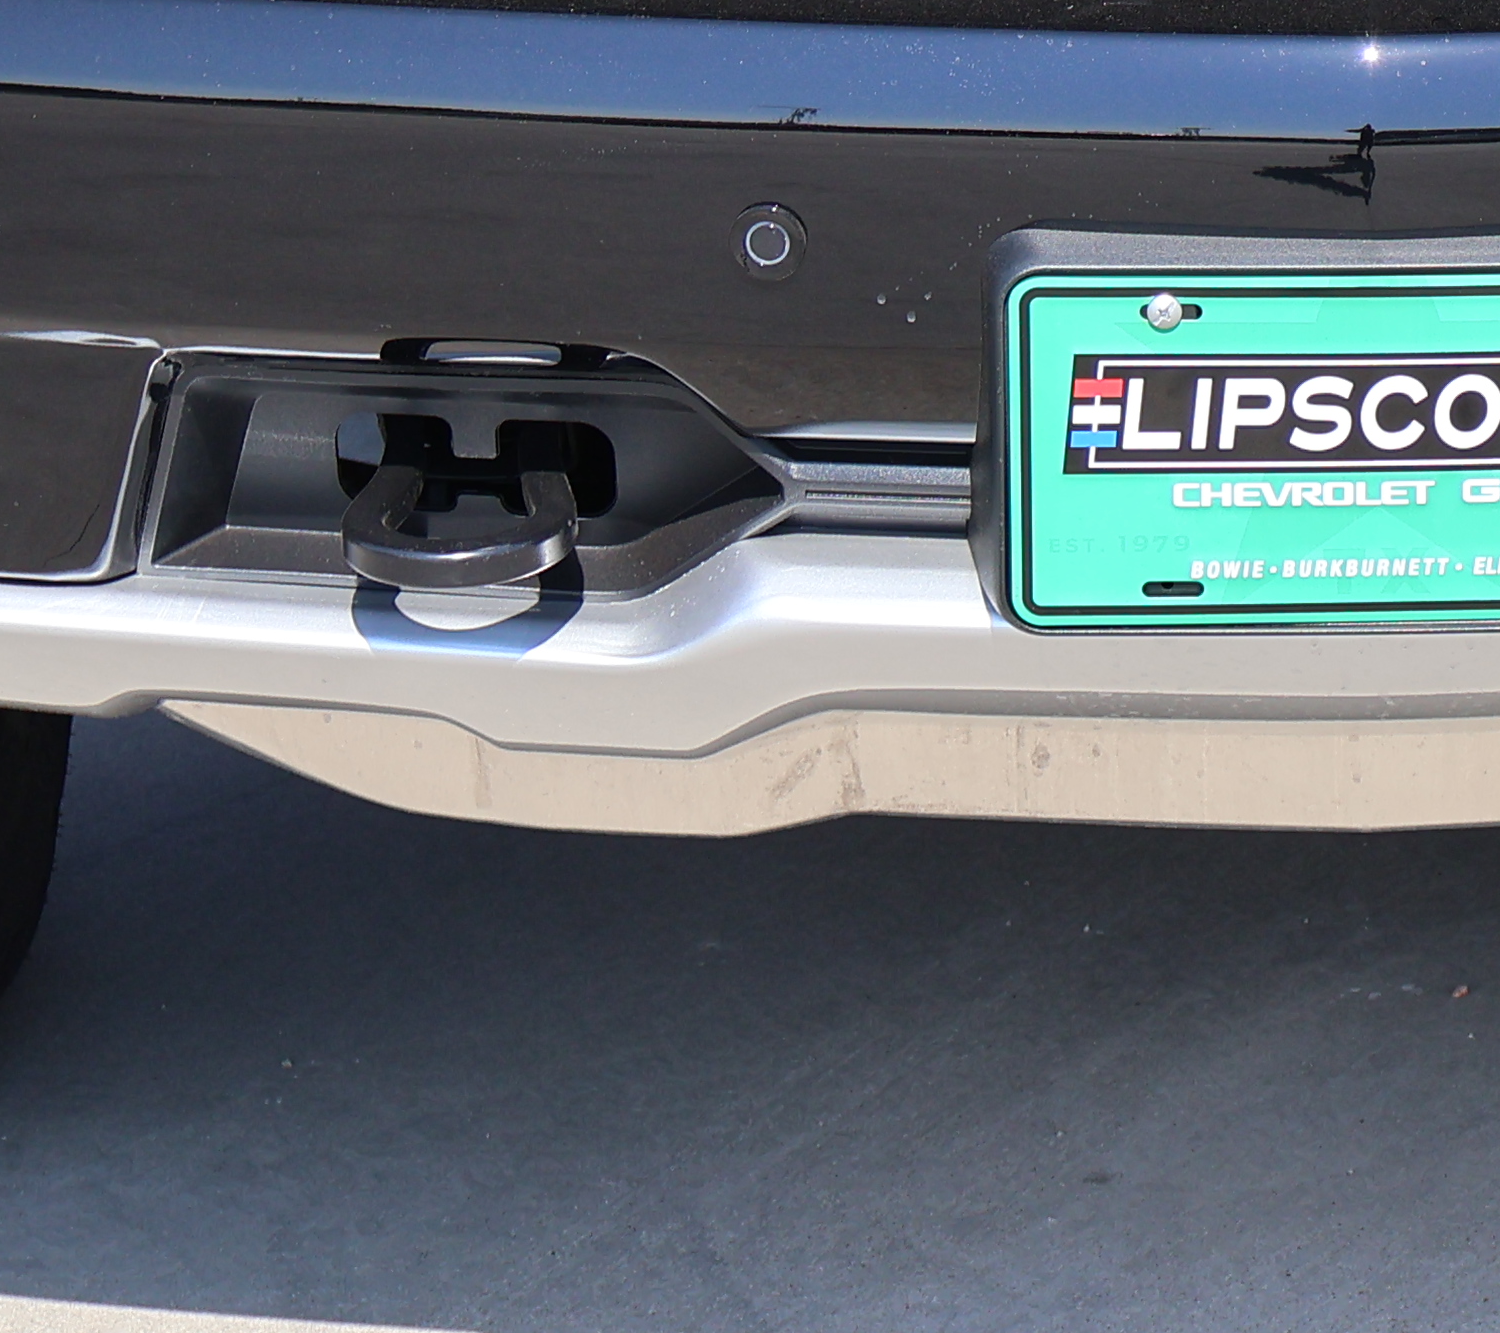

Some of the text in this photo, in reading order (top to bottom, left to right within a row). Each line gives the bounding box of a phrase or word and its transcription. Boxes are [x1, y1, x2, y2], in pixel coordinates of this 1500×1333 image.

[1172, 480, 1436, 508] CHEVROLET
[1118, 534, 1191, 553] 1979
[1190, 559, 1265, 580] BOWIE
[1282, 556, 1450, 579] BURKBURNETT
